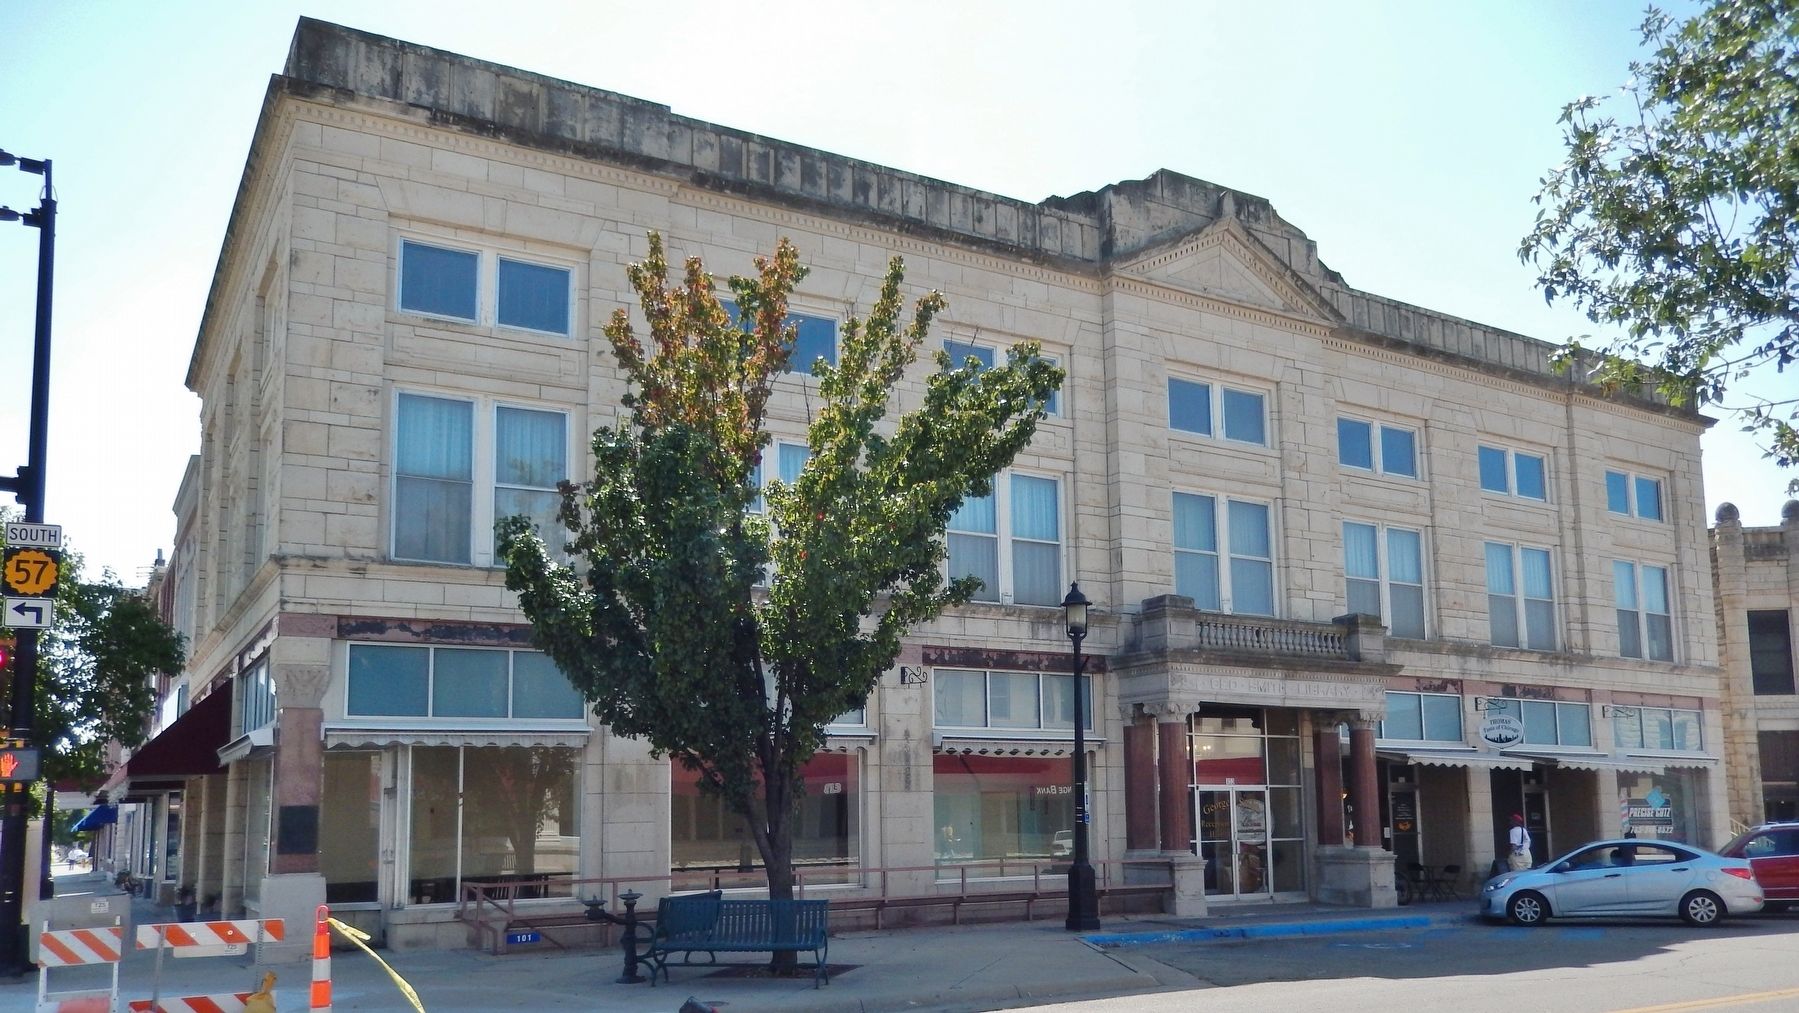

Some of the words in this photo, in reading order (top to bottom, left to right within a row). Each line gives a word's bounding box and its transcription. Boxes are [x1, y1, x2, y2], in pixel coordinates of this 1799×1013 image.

[9, 527, 57, 543] SOUTH
[15, 559, 49, 585] 57
[1297, 682, 1351, 698] LIBRARY
[1203, 800, 1231, 815] George
[1629, 807, 1654, 818] PRECISE
[1655, 807, 1671, 818] CUTZ
[517, 934, 532, 943] 101
